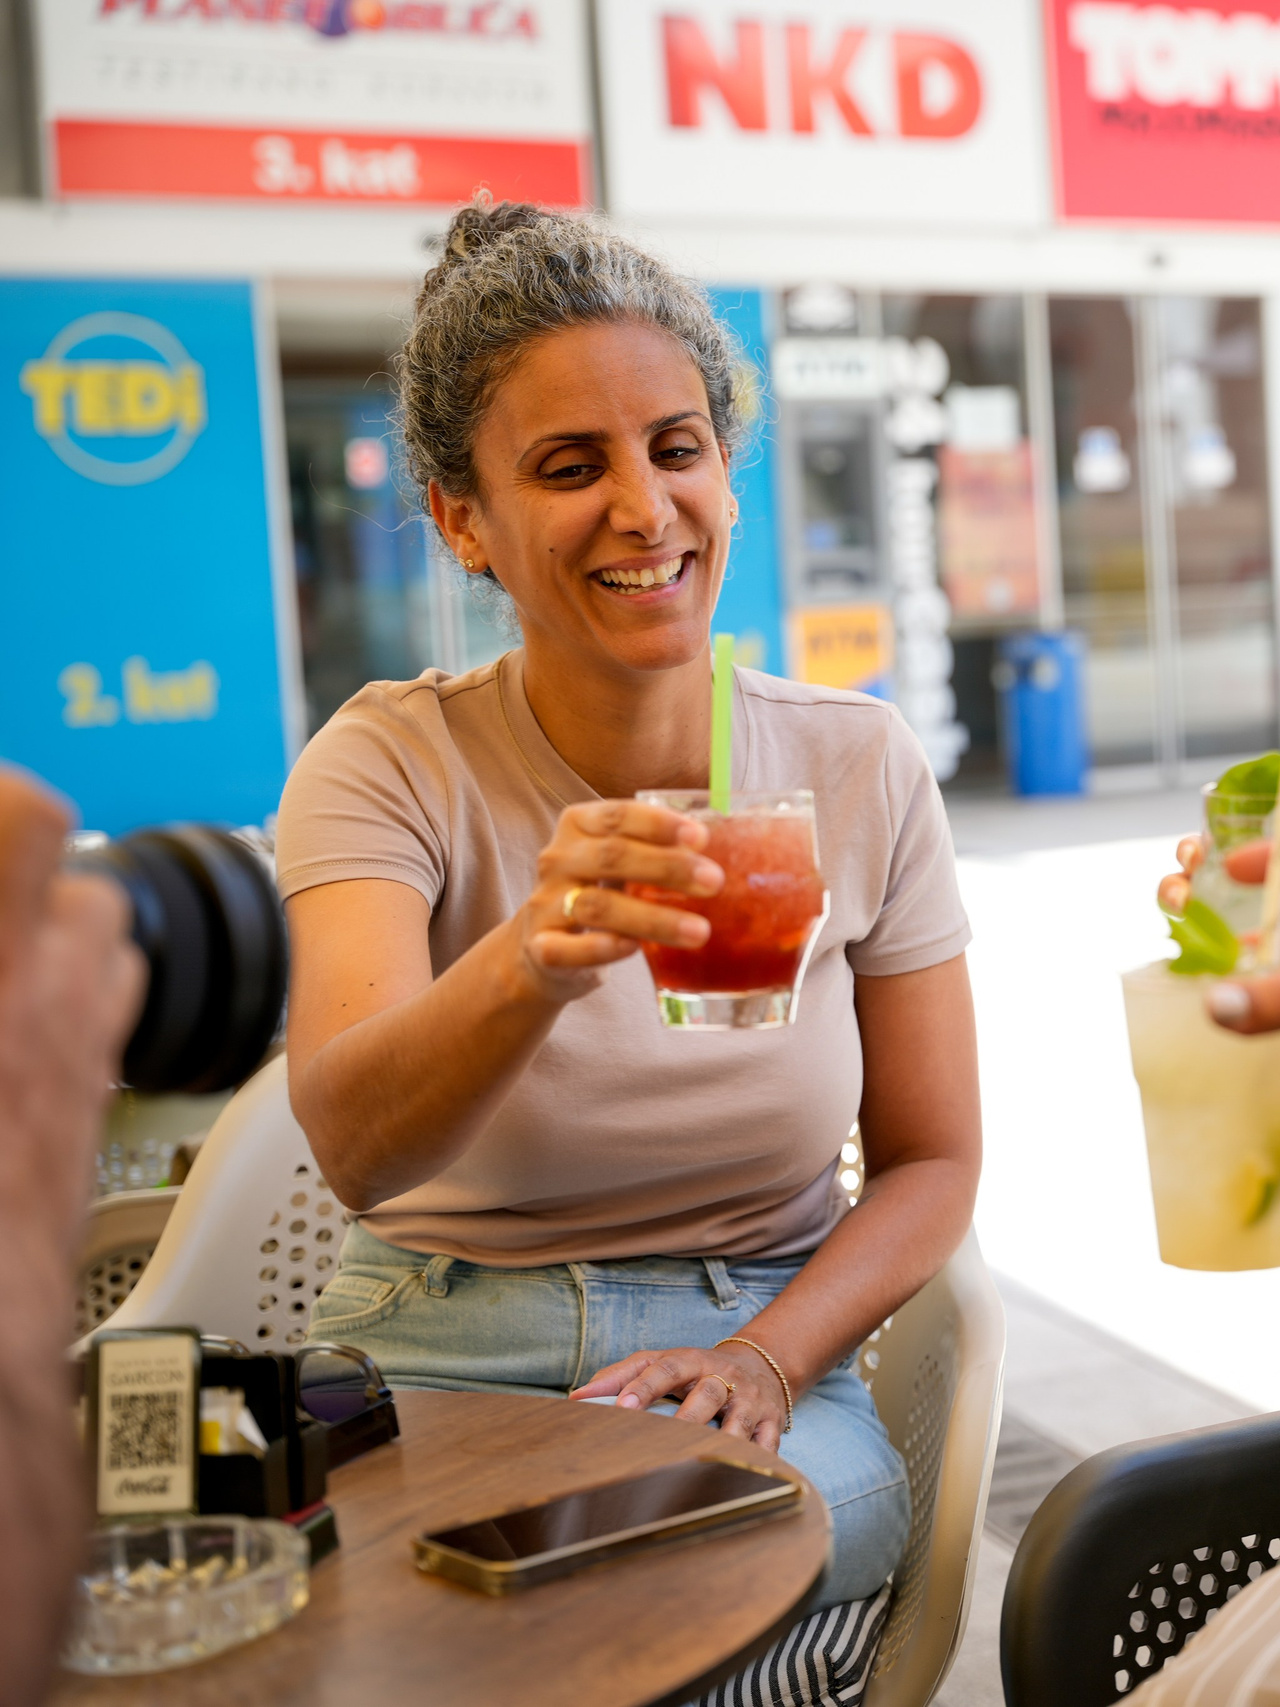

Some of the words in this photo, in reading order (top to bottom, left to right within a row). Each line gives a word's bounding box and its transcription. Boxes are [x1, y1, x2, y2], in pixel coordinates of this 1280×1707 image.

[658, 12, 986, 143] NKD
[252, 134, 314, 193] 3.
[319, 139, 421, 197] kat
